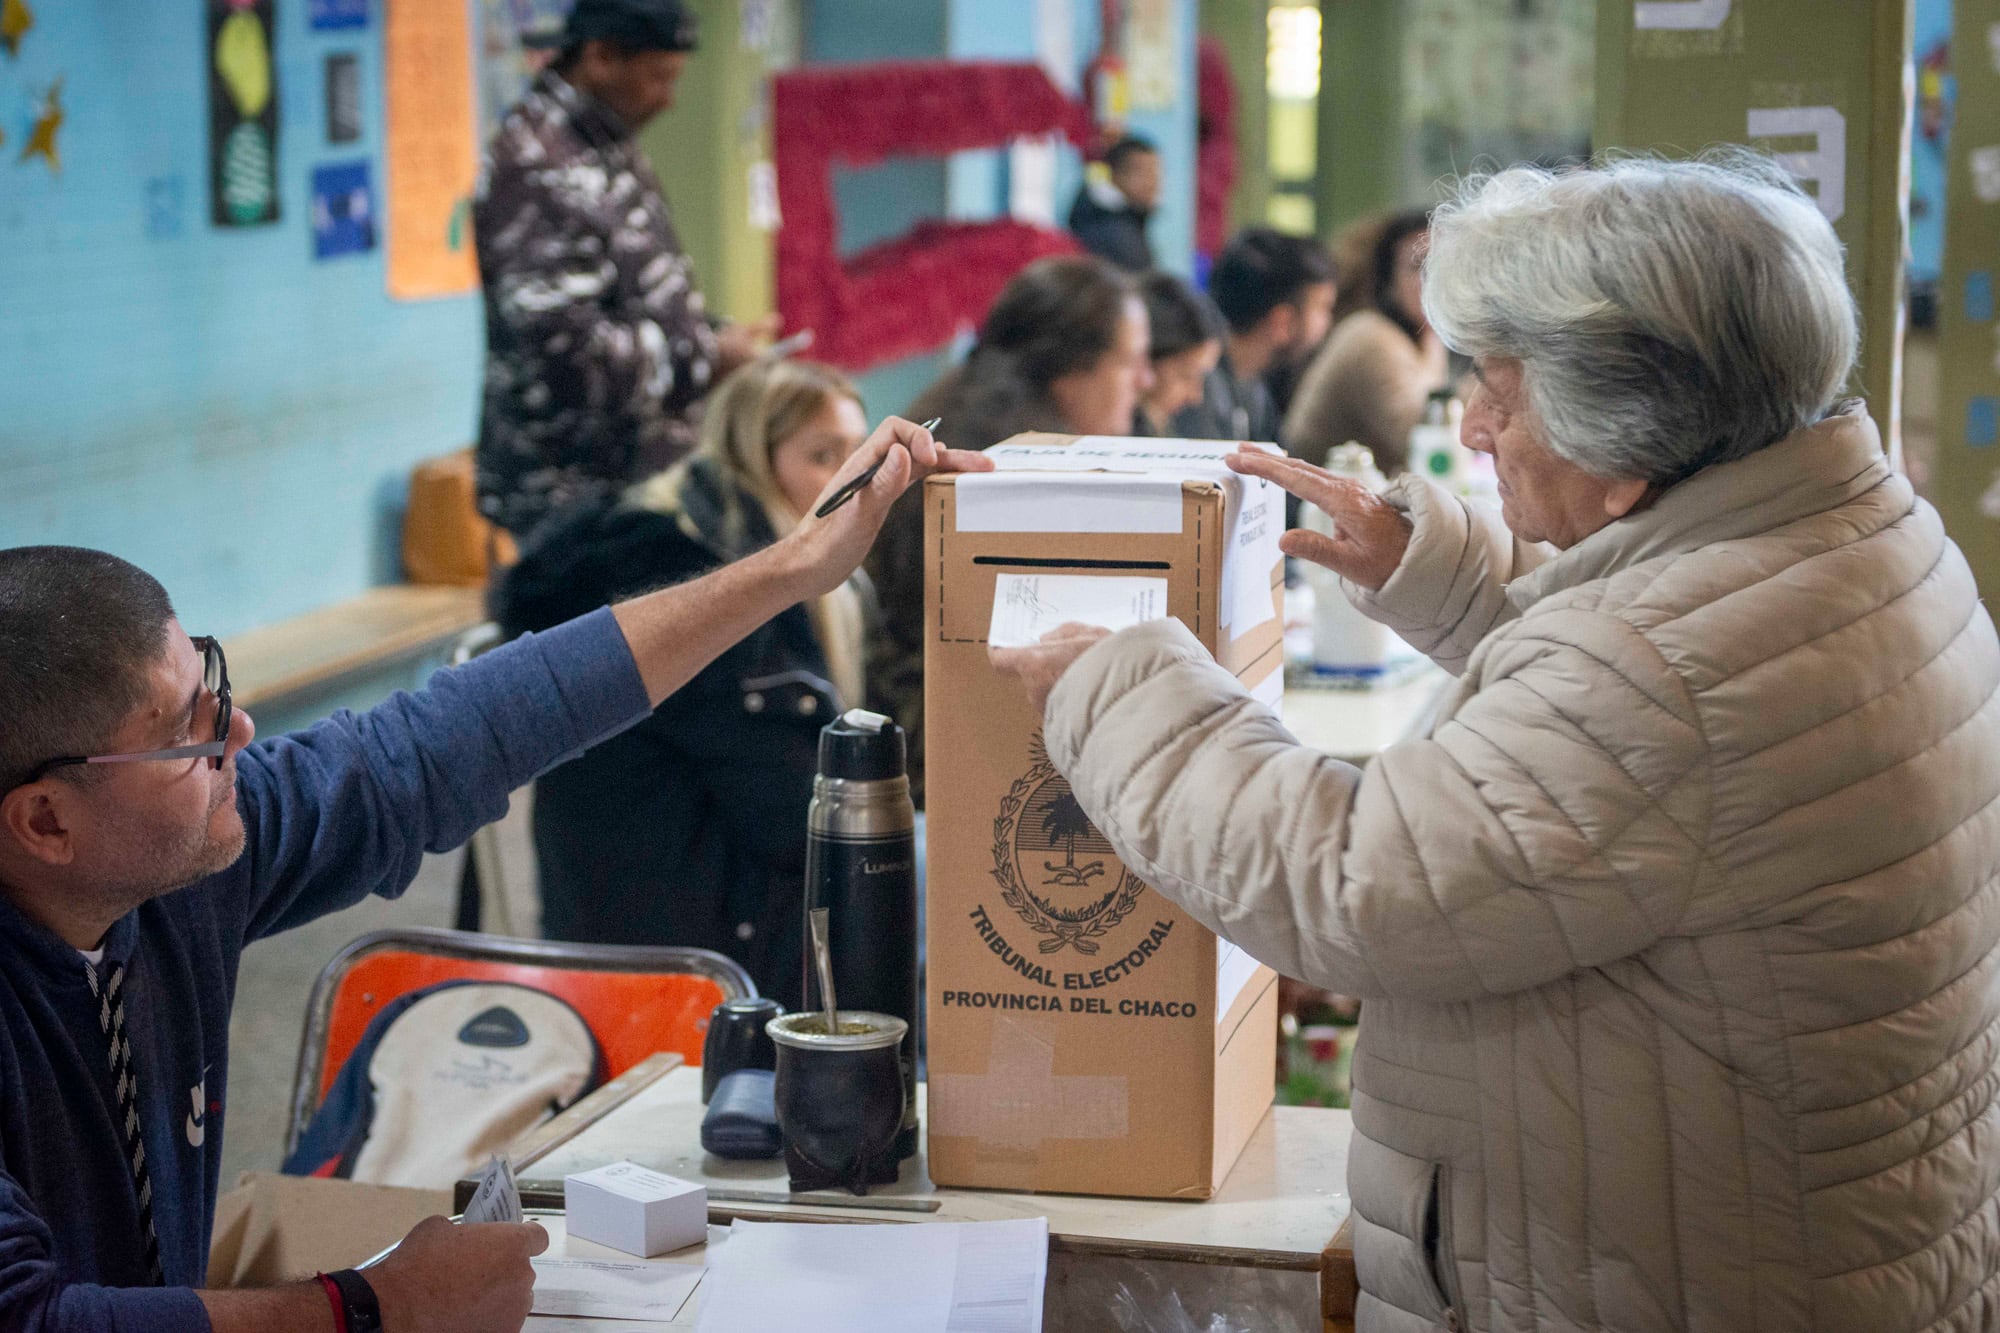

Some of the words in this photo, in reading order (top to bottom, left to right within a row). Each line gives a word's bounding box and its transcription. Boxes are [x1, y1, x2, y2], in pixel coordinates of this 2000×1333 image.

[968, 904, 1057, 988] TRIBUNAL
[1063, 917, 1175, 990] ELECTORAL
[942, 990, 1063, 1012] PROVINCIA
[1069, 997, 1113, 1014] DEL
[1118, 999, 1198, 1018] CHACO
